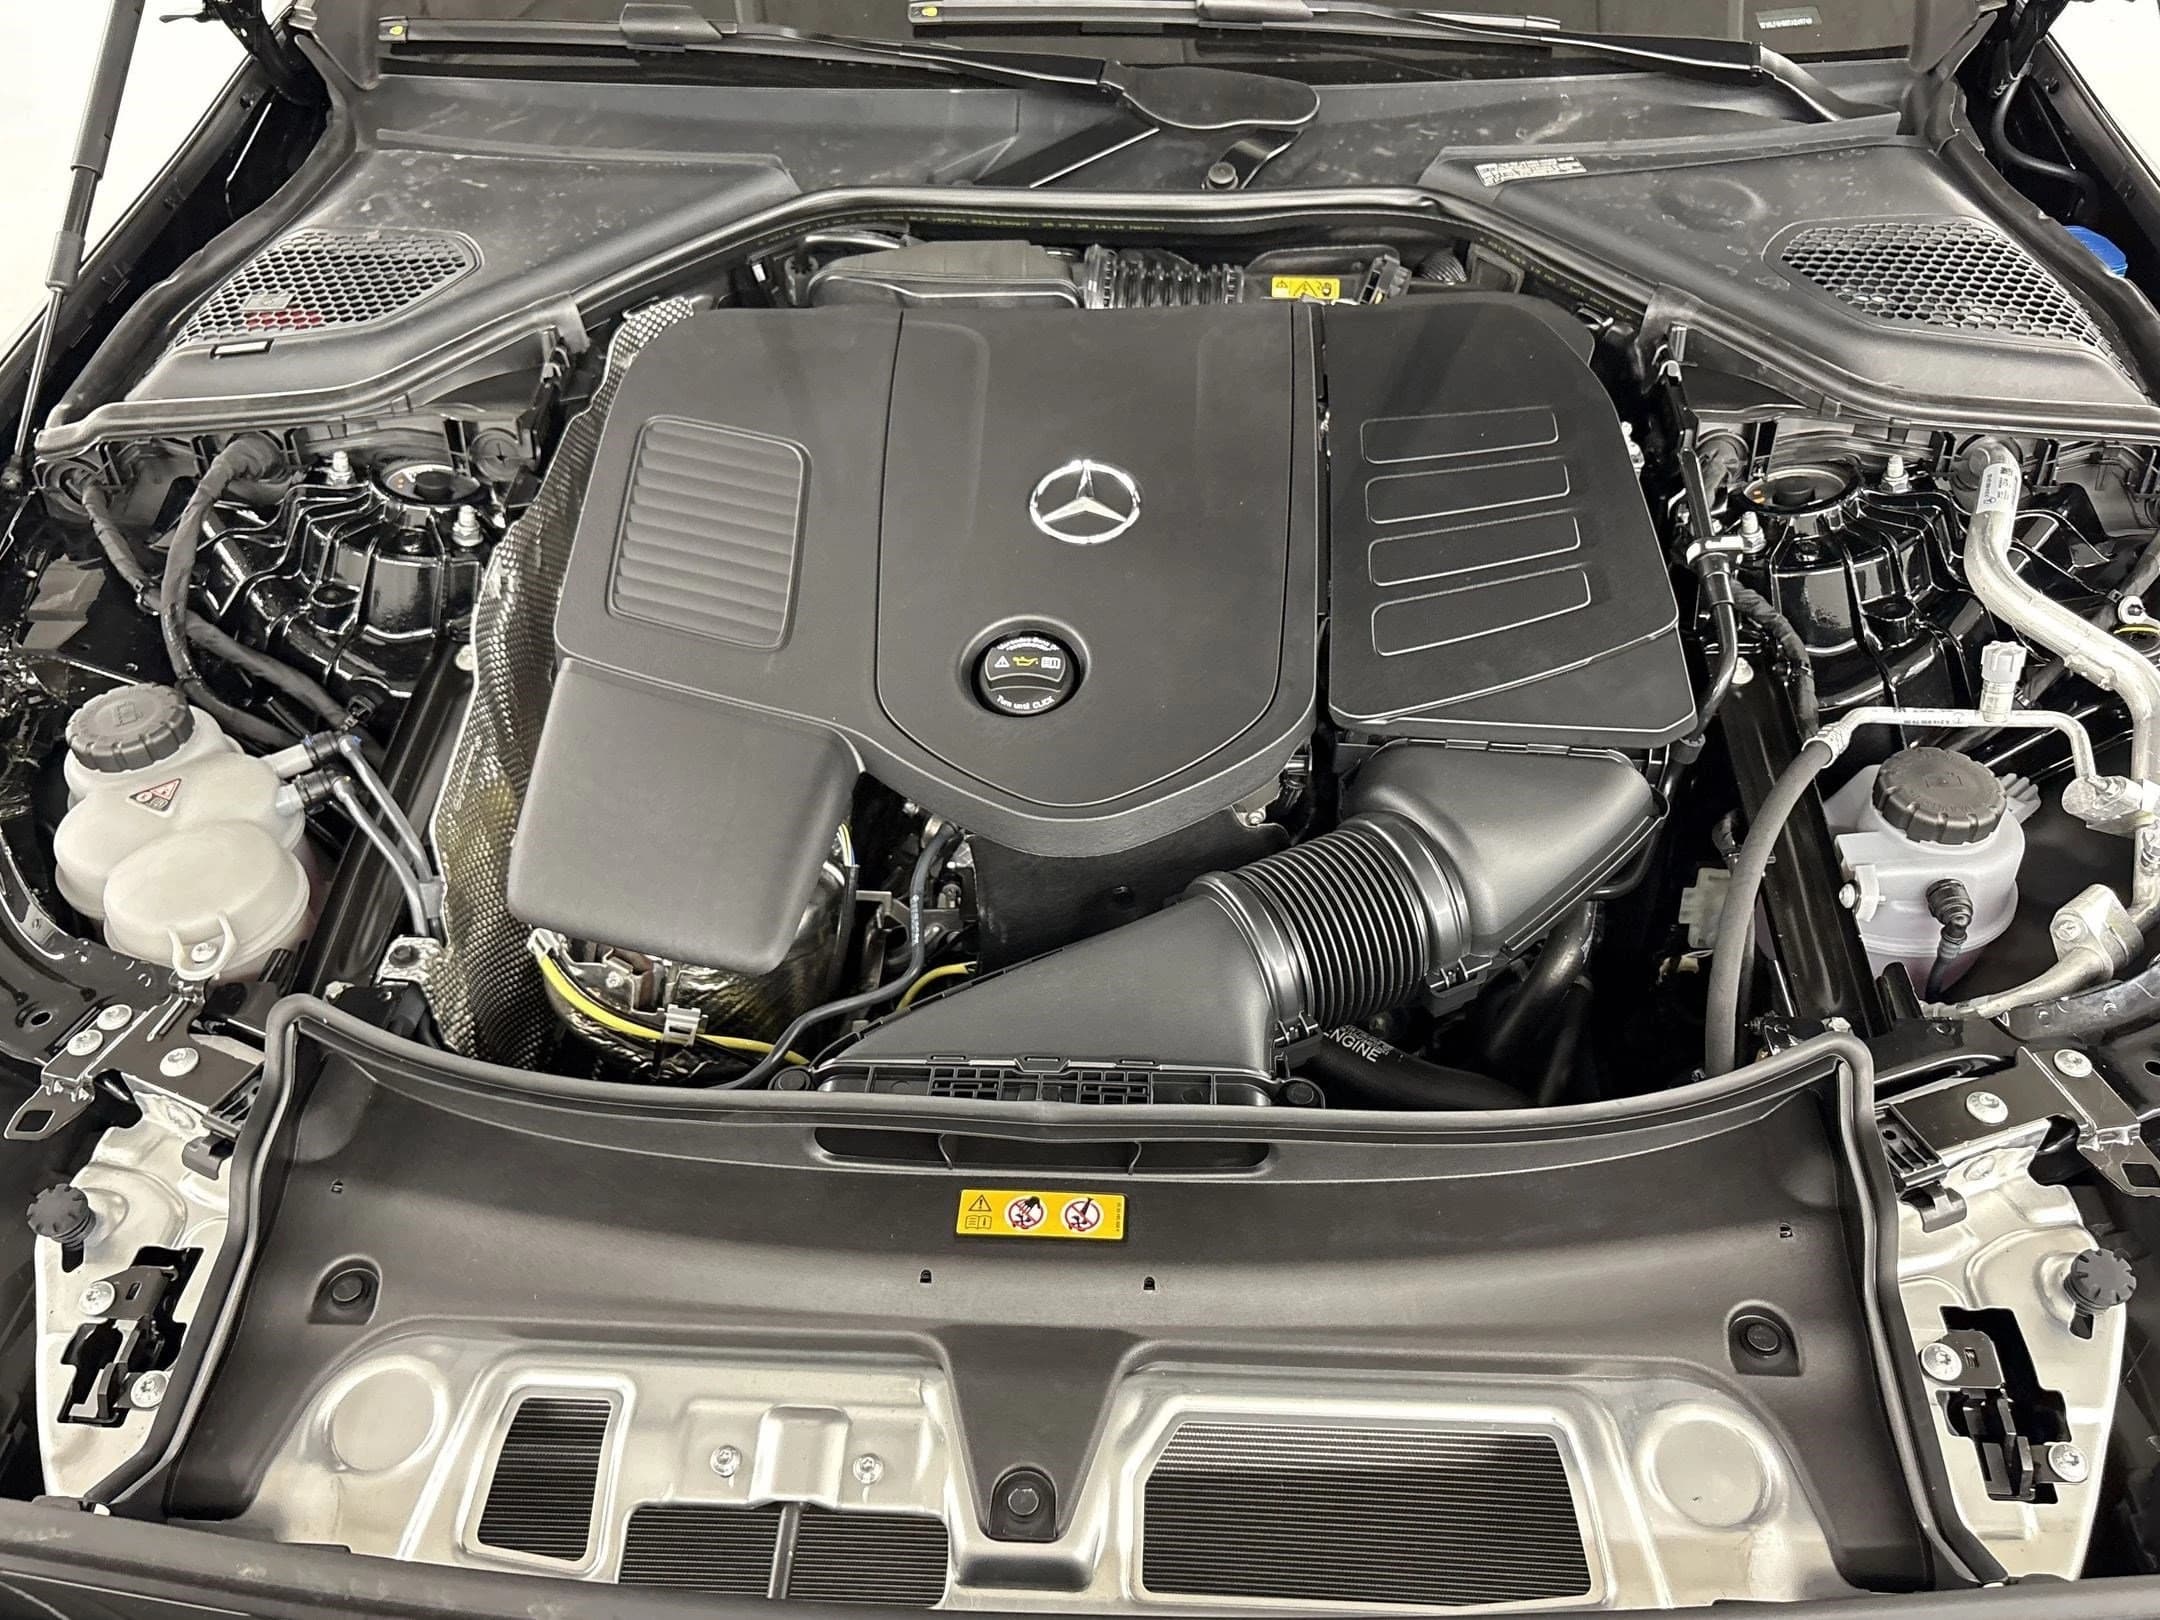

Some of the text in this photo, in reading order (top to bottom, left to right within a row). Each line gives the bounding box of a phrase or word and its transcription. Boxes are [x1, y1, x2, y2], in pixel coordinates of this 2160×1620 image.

[997, 695, 1056, 710] Turn until CLICK
[1323, 1028, 1382, 1063] NGINE
